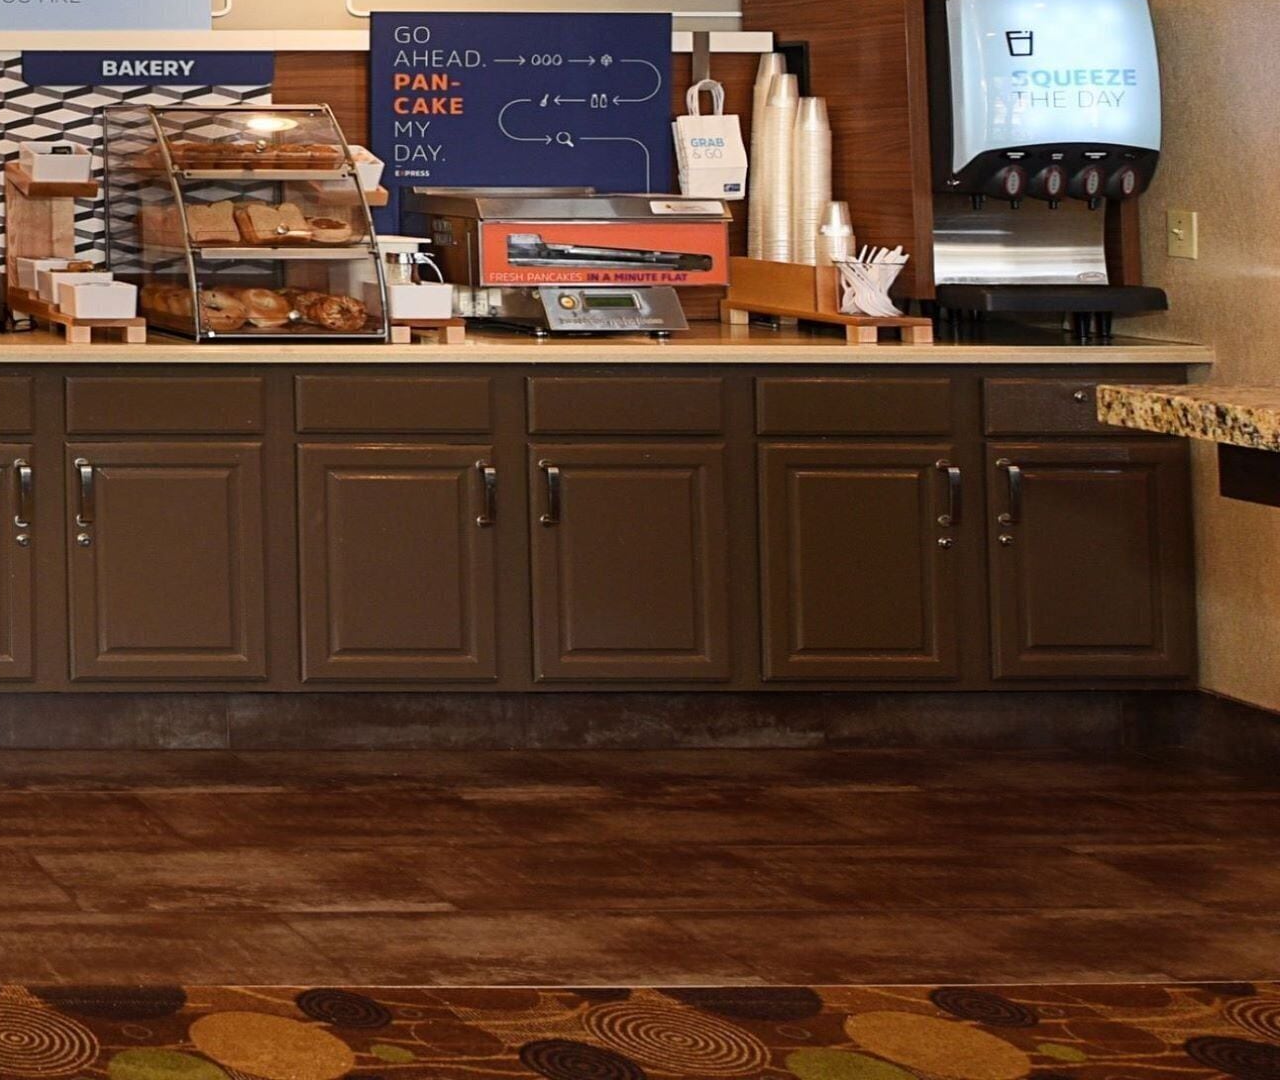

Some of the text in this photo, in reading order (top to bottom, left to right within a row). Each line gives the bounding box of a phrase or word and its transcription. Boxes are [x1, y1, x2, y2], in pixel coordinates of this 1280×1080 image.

[394, 26, 431, 44] GO
[393, 50, 487, 68] AHEAD.
[101, 60, 195, 77] BAKERY
[394, 73, 461, 91] PAN-
[1011, 69, 1137, 88] SQUEEZE
[394, 97, 464, 115] CAKE
[1012, 90, 1126, 108] THE DAY
[394, 121, 431, 138] MY
[690, 137, 725, 148] GRAB
[394, 144, 446, 162] DAY.
[692, 148, 723, 160] & GO
[490, 272, 689, 283] FRESH PANCAKES IN A MINUTE FLAT
